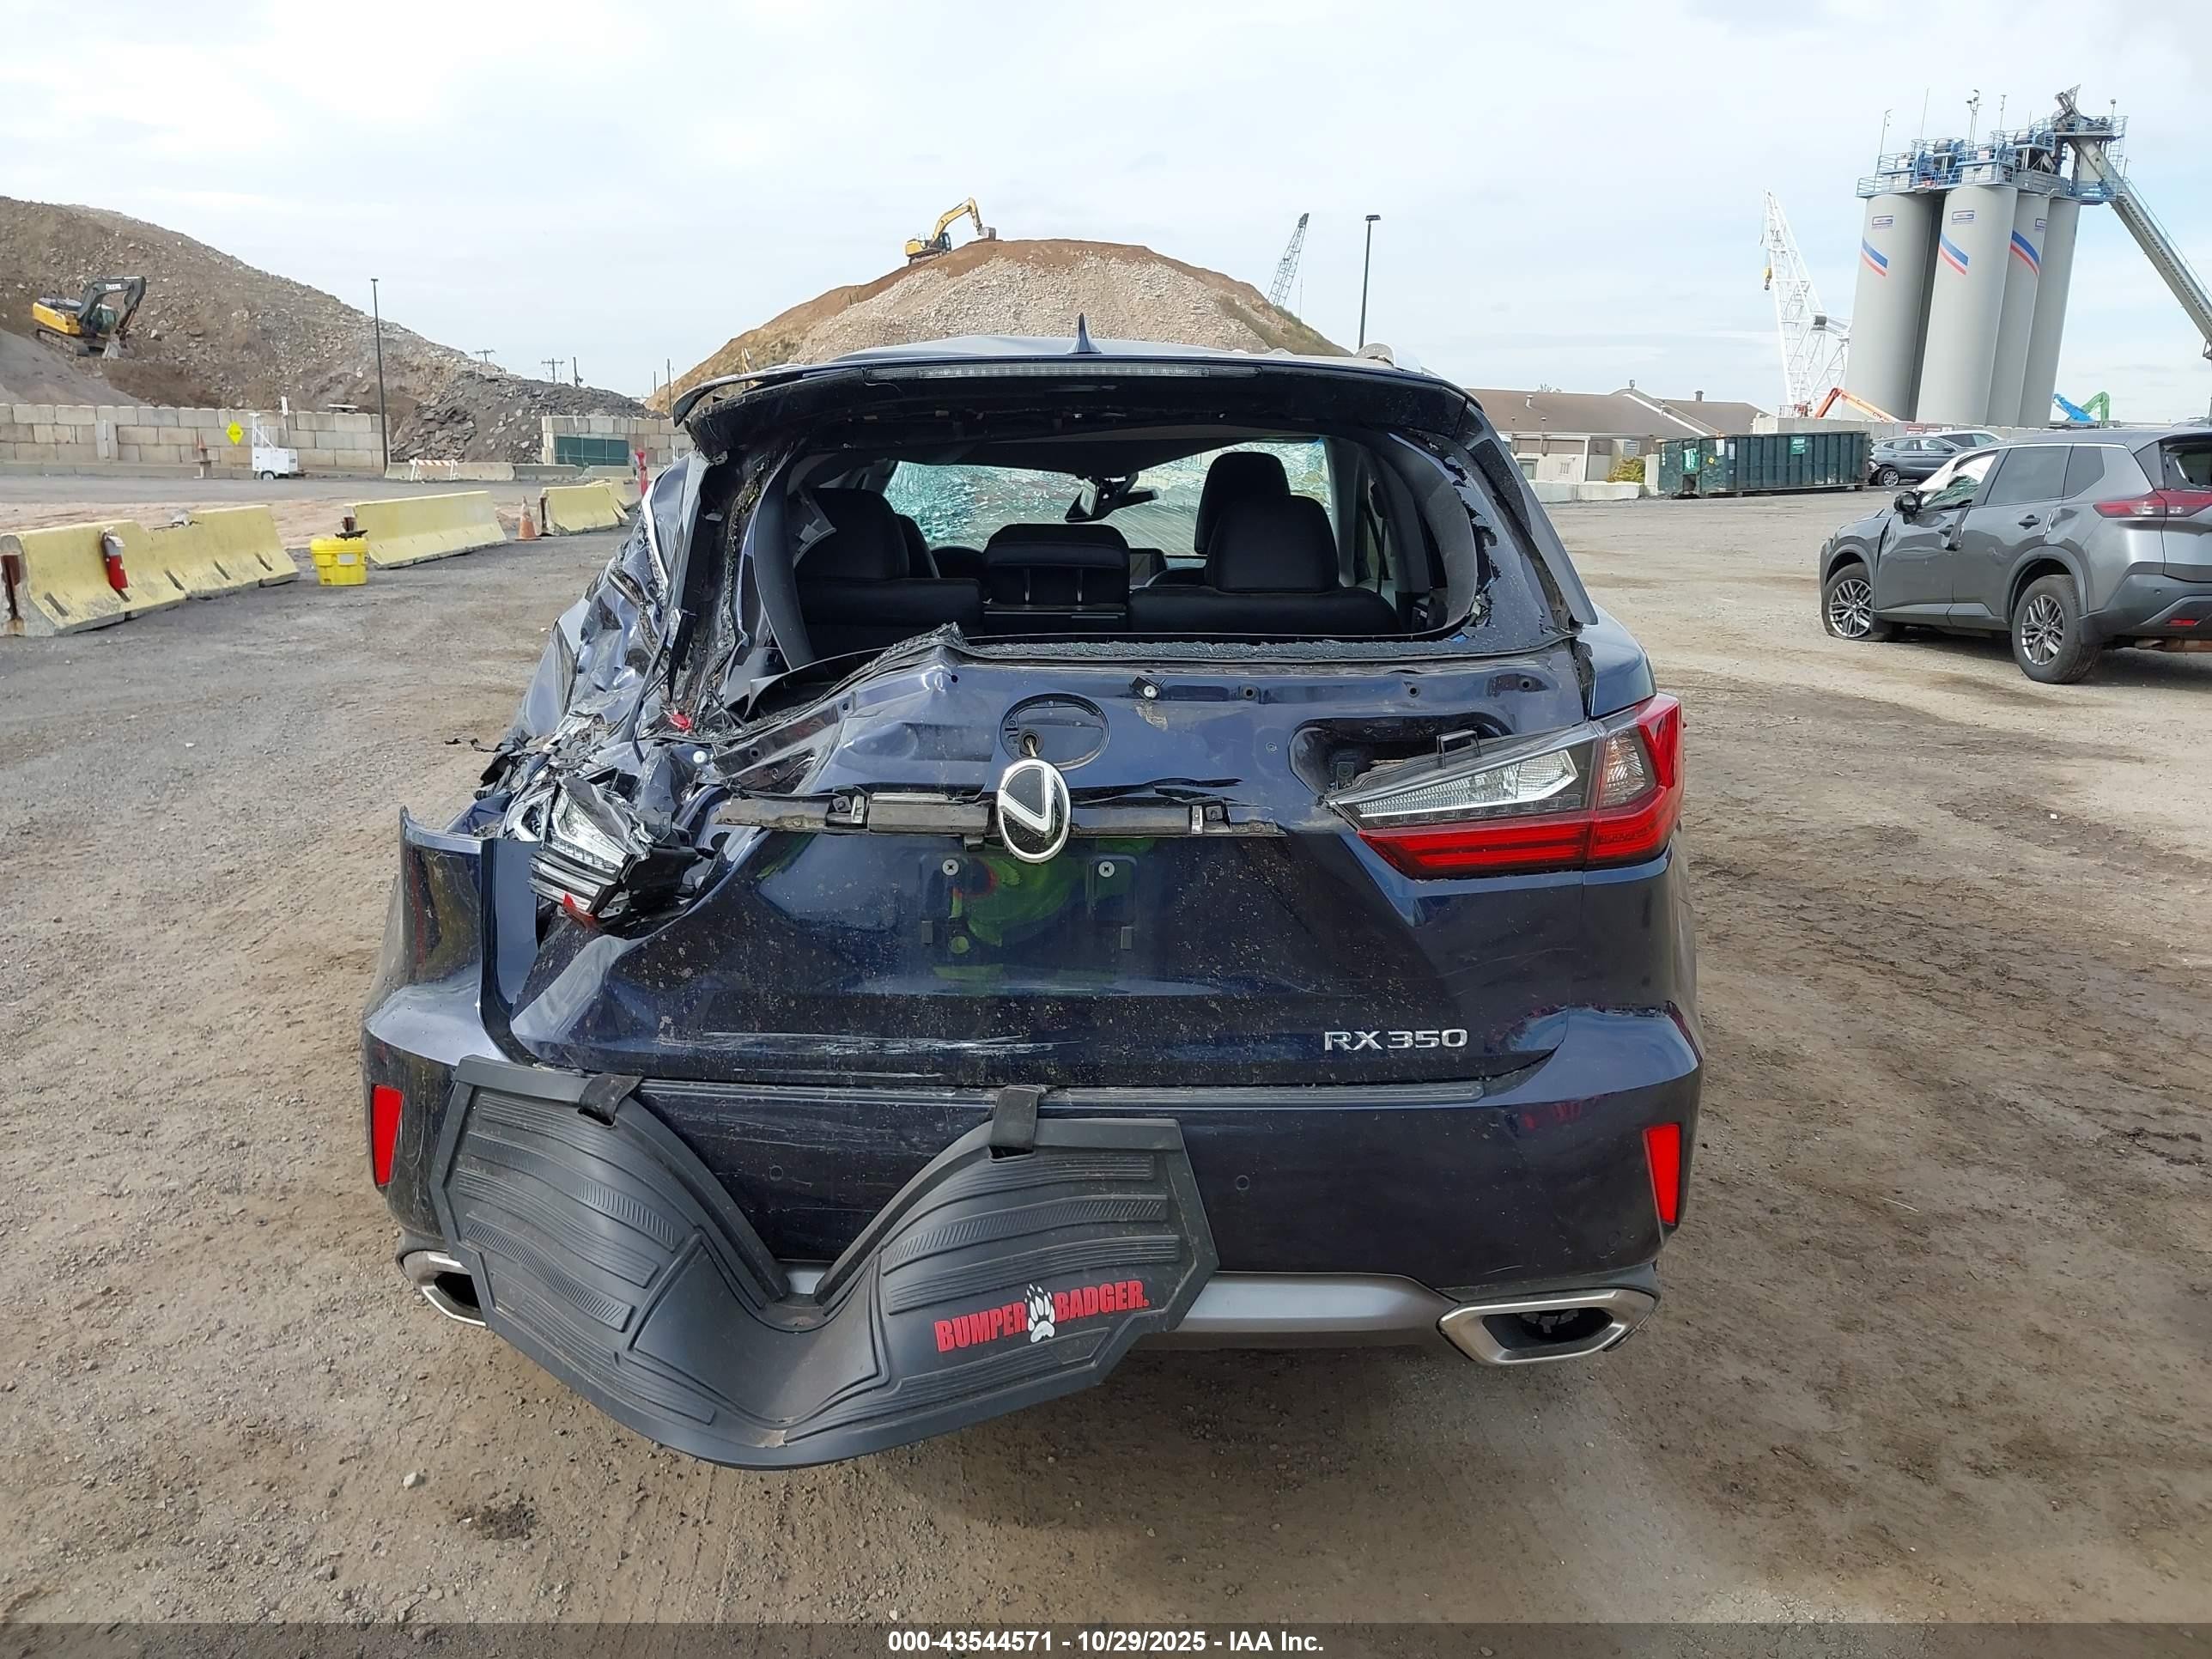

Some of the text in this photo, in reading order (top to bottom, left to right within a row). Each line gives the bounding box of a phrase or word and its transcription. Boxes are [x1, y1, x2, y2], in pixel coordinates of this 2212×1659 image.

[1324, 1029, 1468, 1051] RX 350
[933, 1301, 1028, 1353] BUMPER
